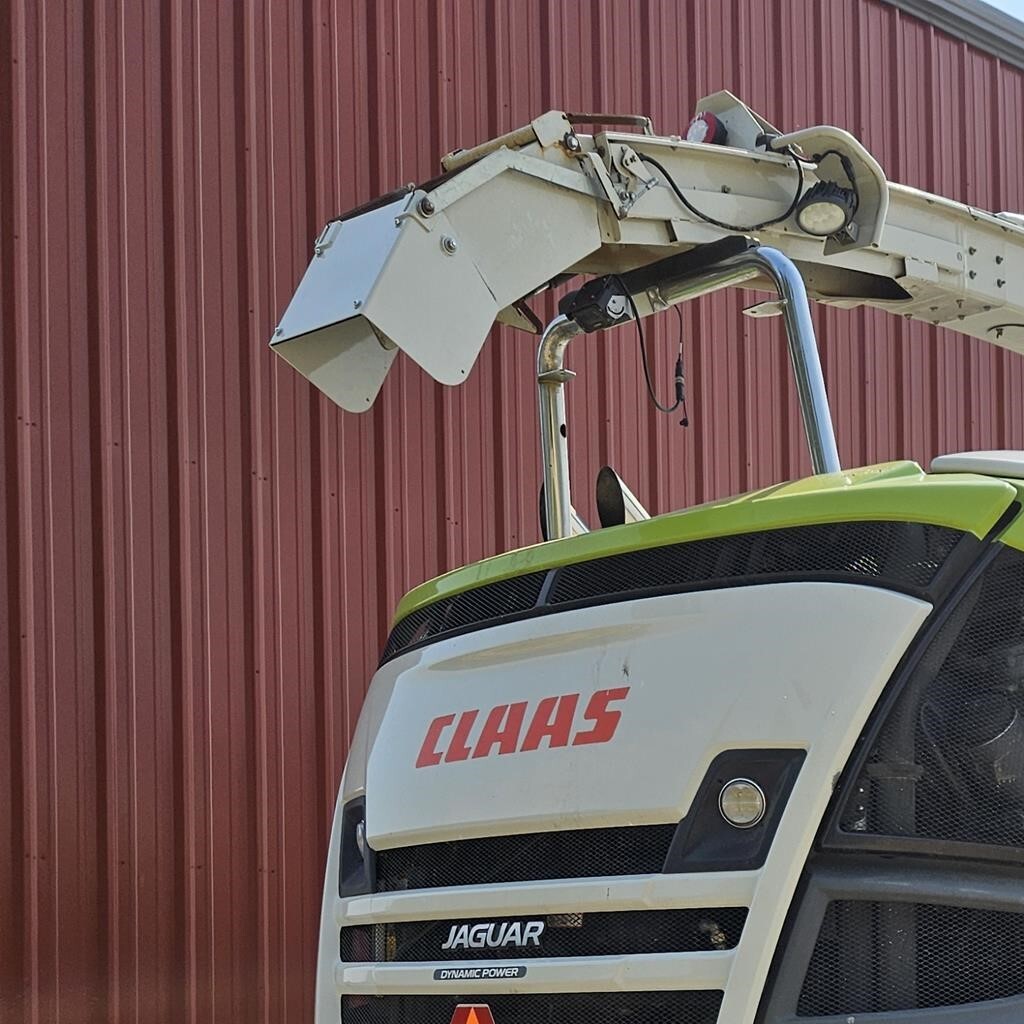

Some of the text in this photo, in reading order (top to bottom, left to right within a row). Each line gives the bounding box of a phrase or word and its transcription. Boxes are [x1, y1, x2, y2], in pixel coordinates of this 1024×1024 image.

[415, 686, 631, 768] CLAAS
[441, 921, 545, 950] JAGUAR
[440, 967, 519, 979] DYNAMIC POWER
